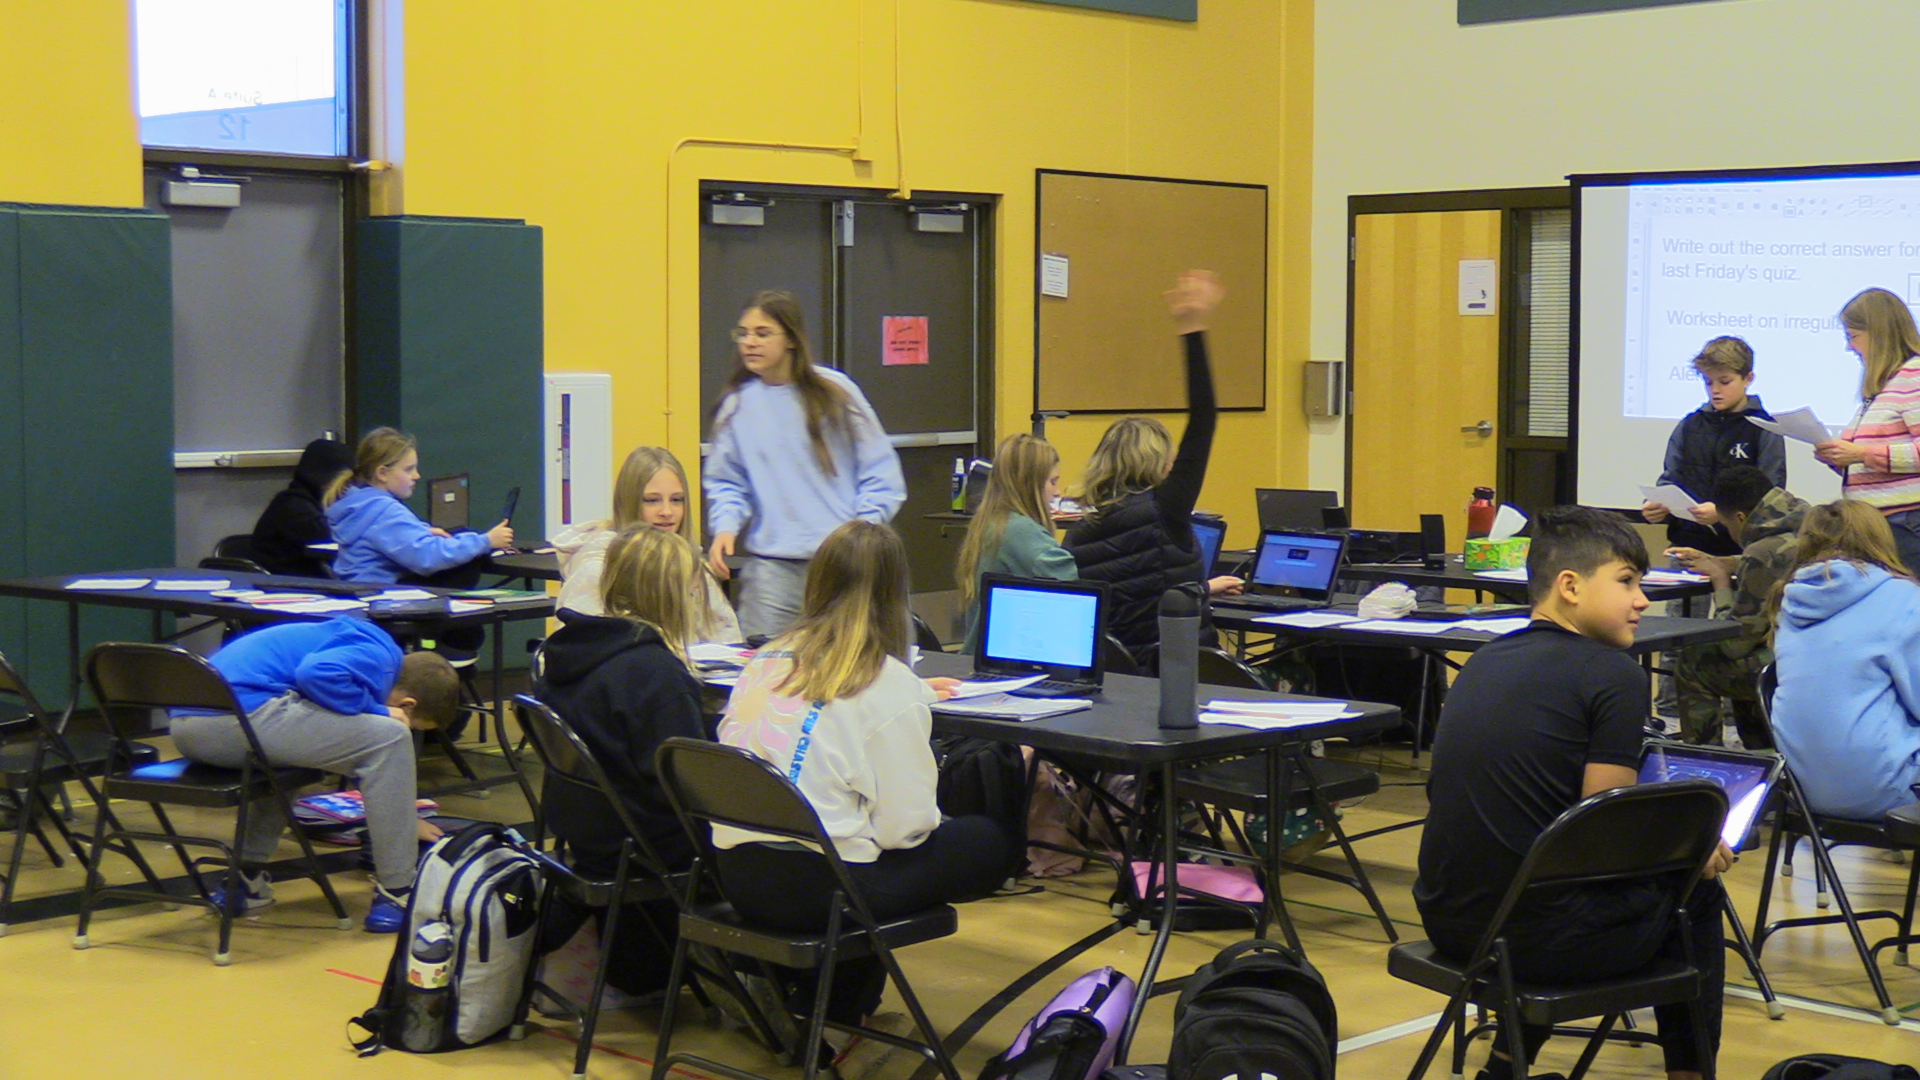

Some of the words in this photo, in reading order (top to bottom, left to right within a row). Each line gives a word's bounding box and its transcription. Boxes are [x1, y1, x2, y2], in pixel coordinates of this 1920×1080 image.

[1662, 237, 1704, 254] Write
[1709, 240, 1734, 255] out
[1739, 240, 1765, 255] the
[1770, 242, 1827, 257] correct
[1832, 244, 1894, 258] answer
[1899, 241, 1920, 258] for
[1662, 262, 1690, 278] last
[1695, 263, 1758, 283] Friday's
[1763, 265, 1801, 284] quiz.
[1667, 310, 1753, 329] Worksheet
[1758, 317, 1778, 329] on
[1784, 314, 1844, 334] irregula
[1669, 366, 1700, 382] Ale
